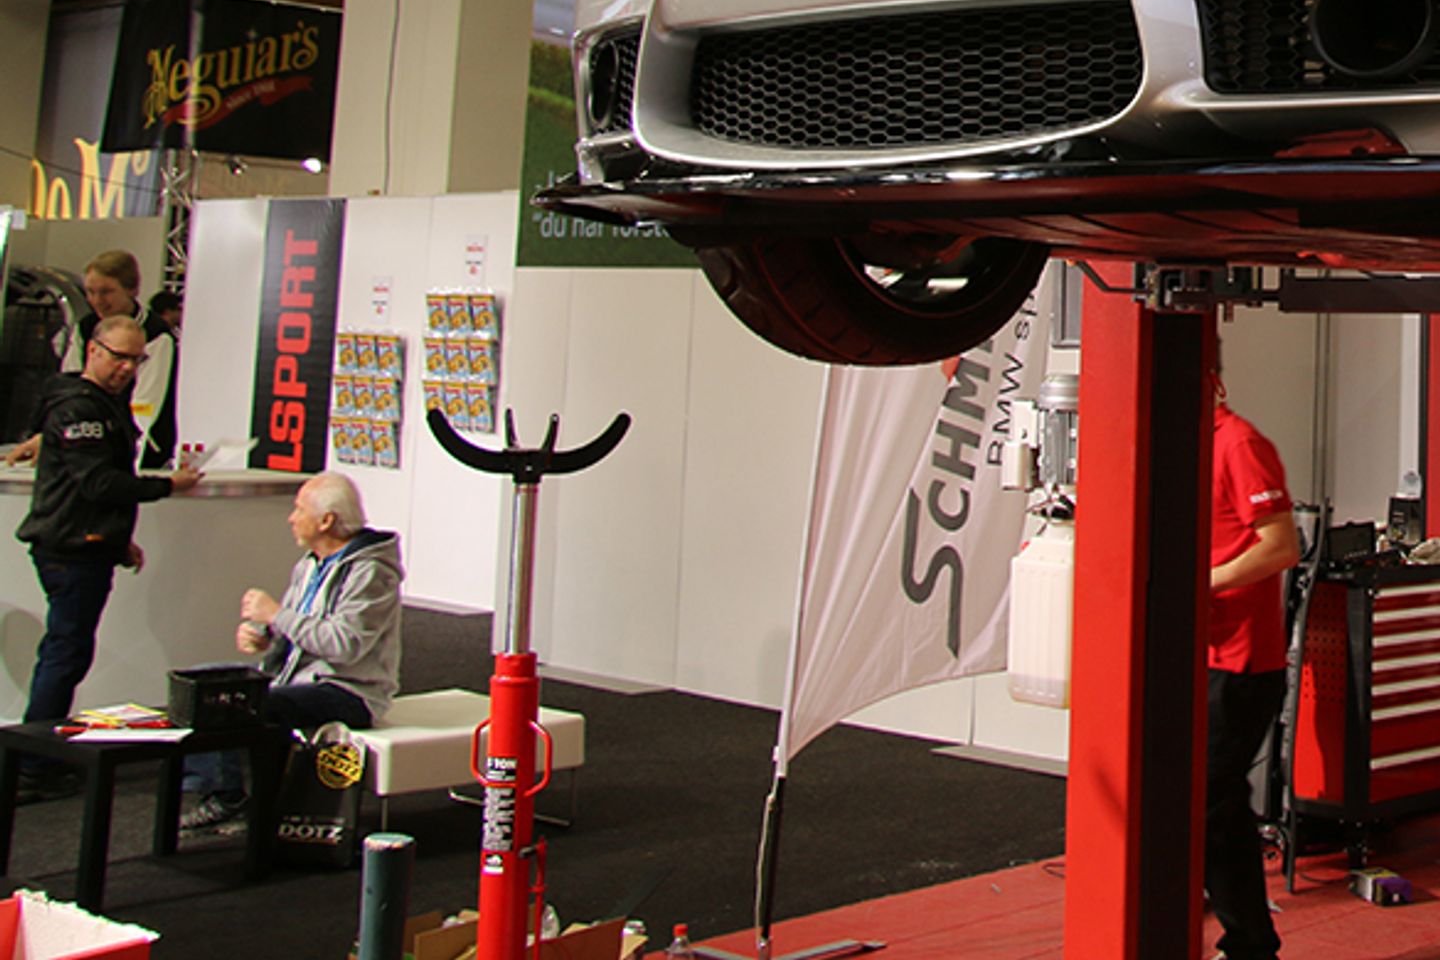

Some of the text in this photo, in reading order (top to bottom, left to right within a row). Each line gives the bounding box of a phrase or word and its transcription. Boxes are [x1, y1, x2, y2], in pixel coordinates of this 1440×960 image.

[143, 20, 319, 128] Meguiar's
[901, 338, 994, 660] SCHM
[278, 824, 343, 844] DOTZ
